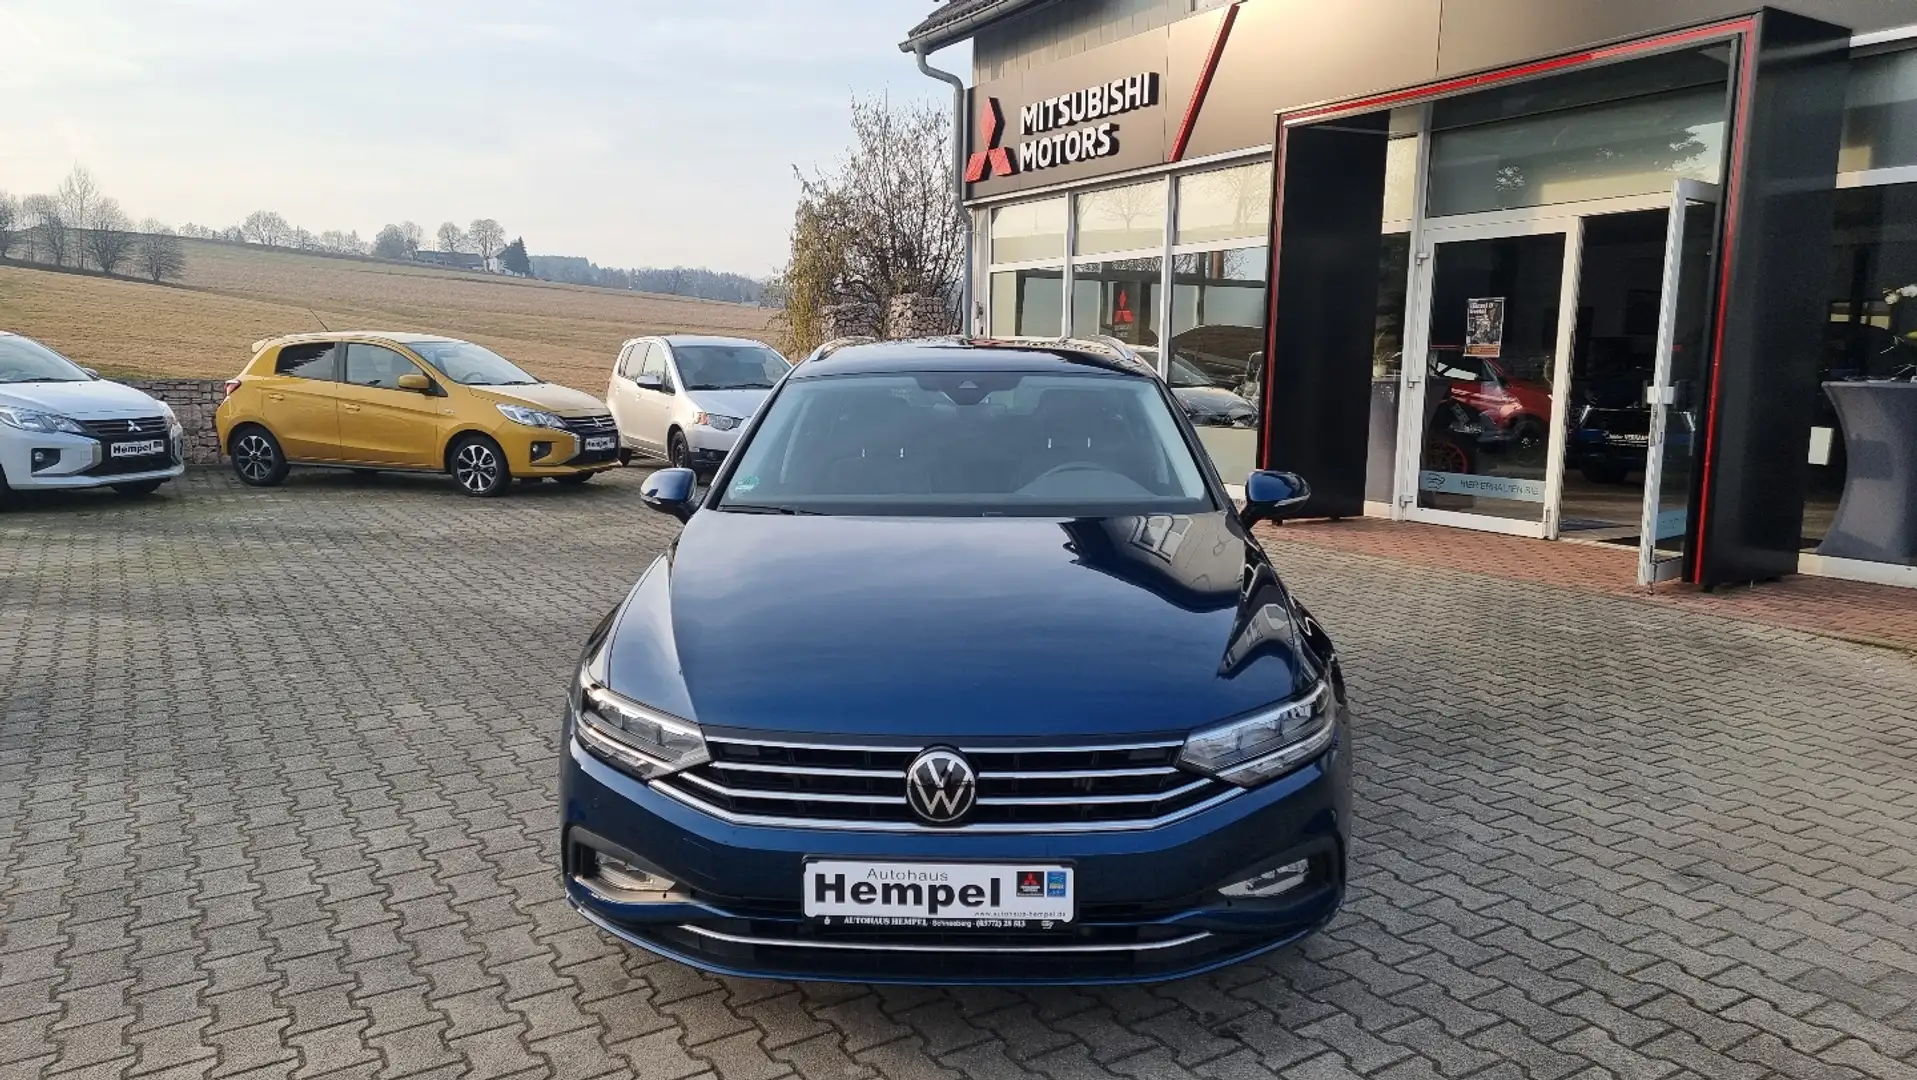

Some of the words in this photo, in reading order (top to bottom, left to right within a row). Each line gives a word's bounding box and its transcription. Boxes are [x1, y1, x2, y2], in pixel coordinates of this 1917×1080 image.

[1020, 72, 1155, 135] MITSUBISHI
[1019, 122, 1116, 172] MOTORS
[113, 443, 152, 454] Hempel
[866, 868, 949, 882] Autohaus
[814, 872, 1001, 916] Hempel
[843, 916, 890, 926] AUTOHAUS
[891, 917, 928, 927] HEMPEL
